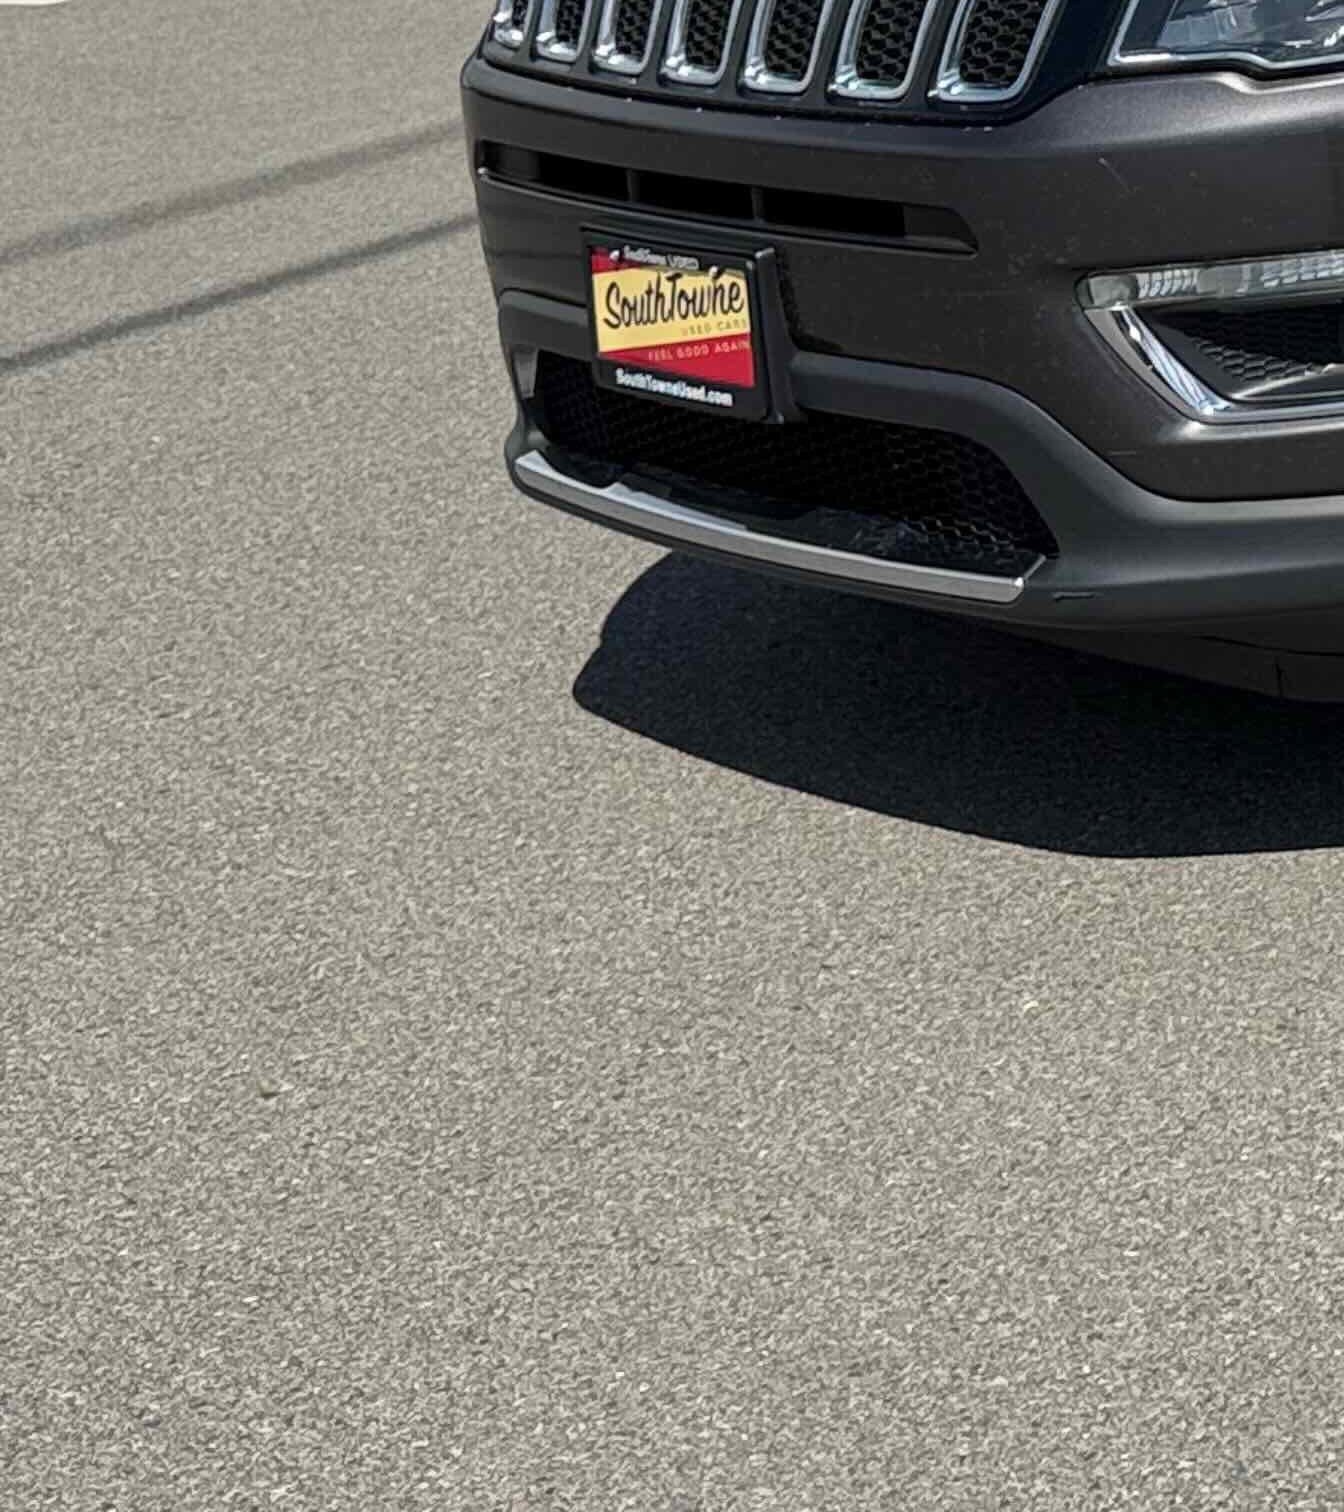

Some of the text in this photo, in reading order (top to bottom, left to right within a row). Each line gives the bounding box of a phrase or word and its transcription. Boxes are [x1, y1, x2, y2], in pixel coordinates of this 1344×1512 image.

[603, 272, 745, 329] SouthTowne
[681, 318, 748, 337] USED CARS
[648, 339, 750, 362] FEEL GOOD AGAIN
